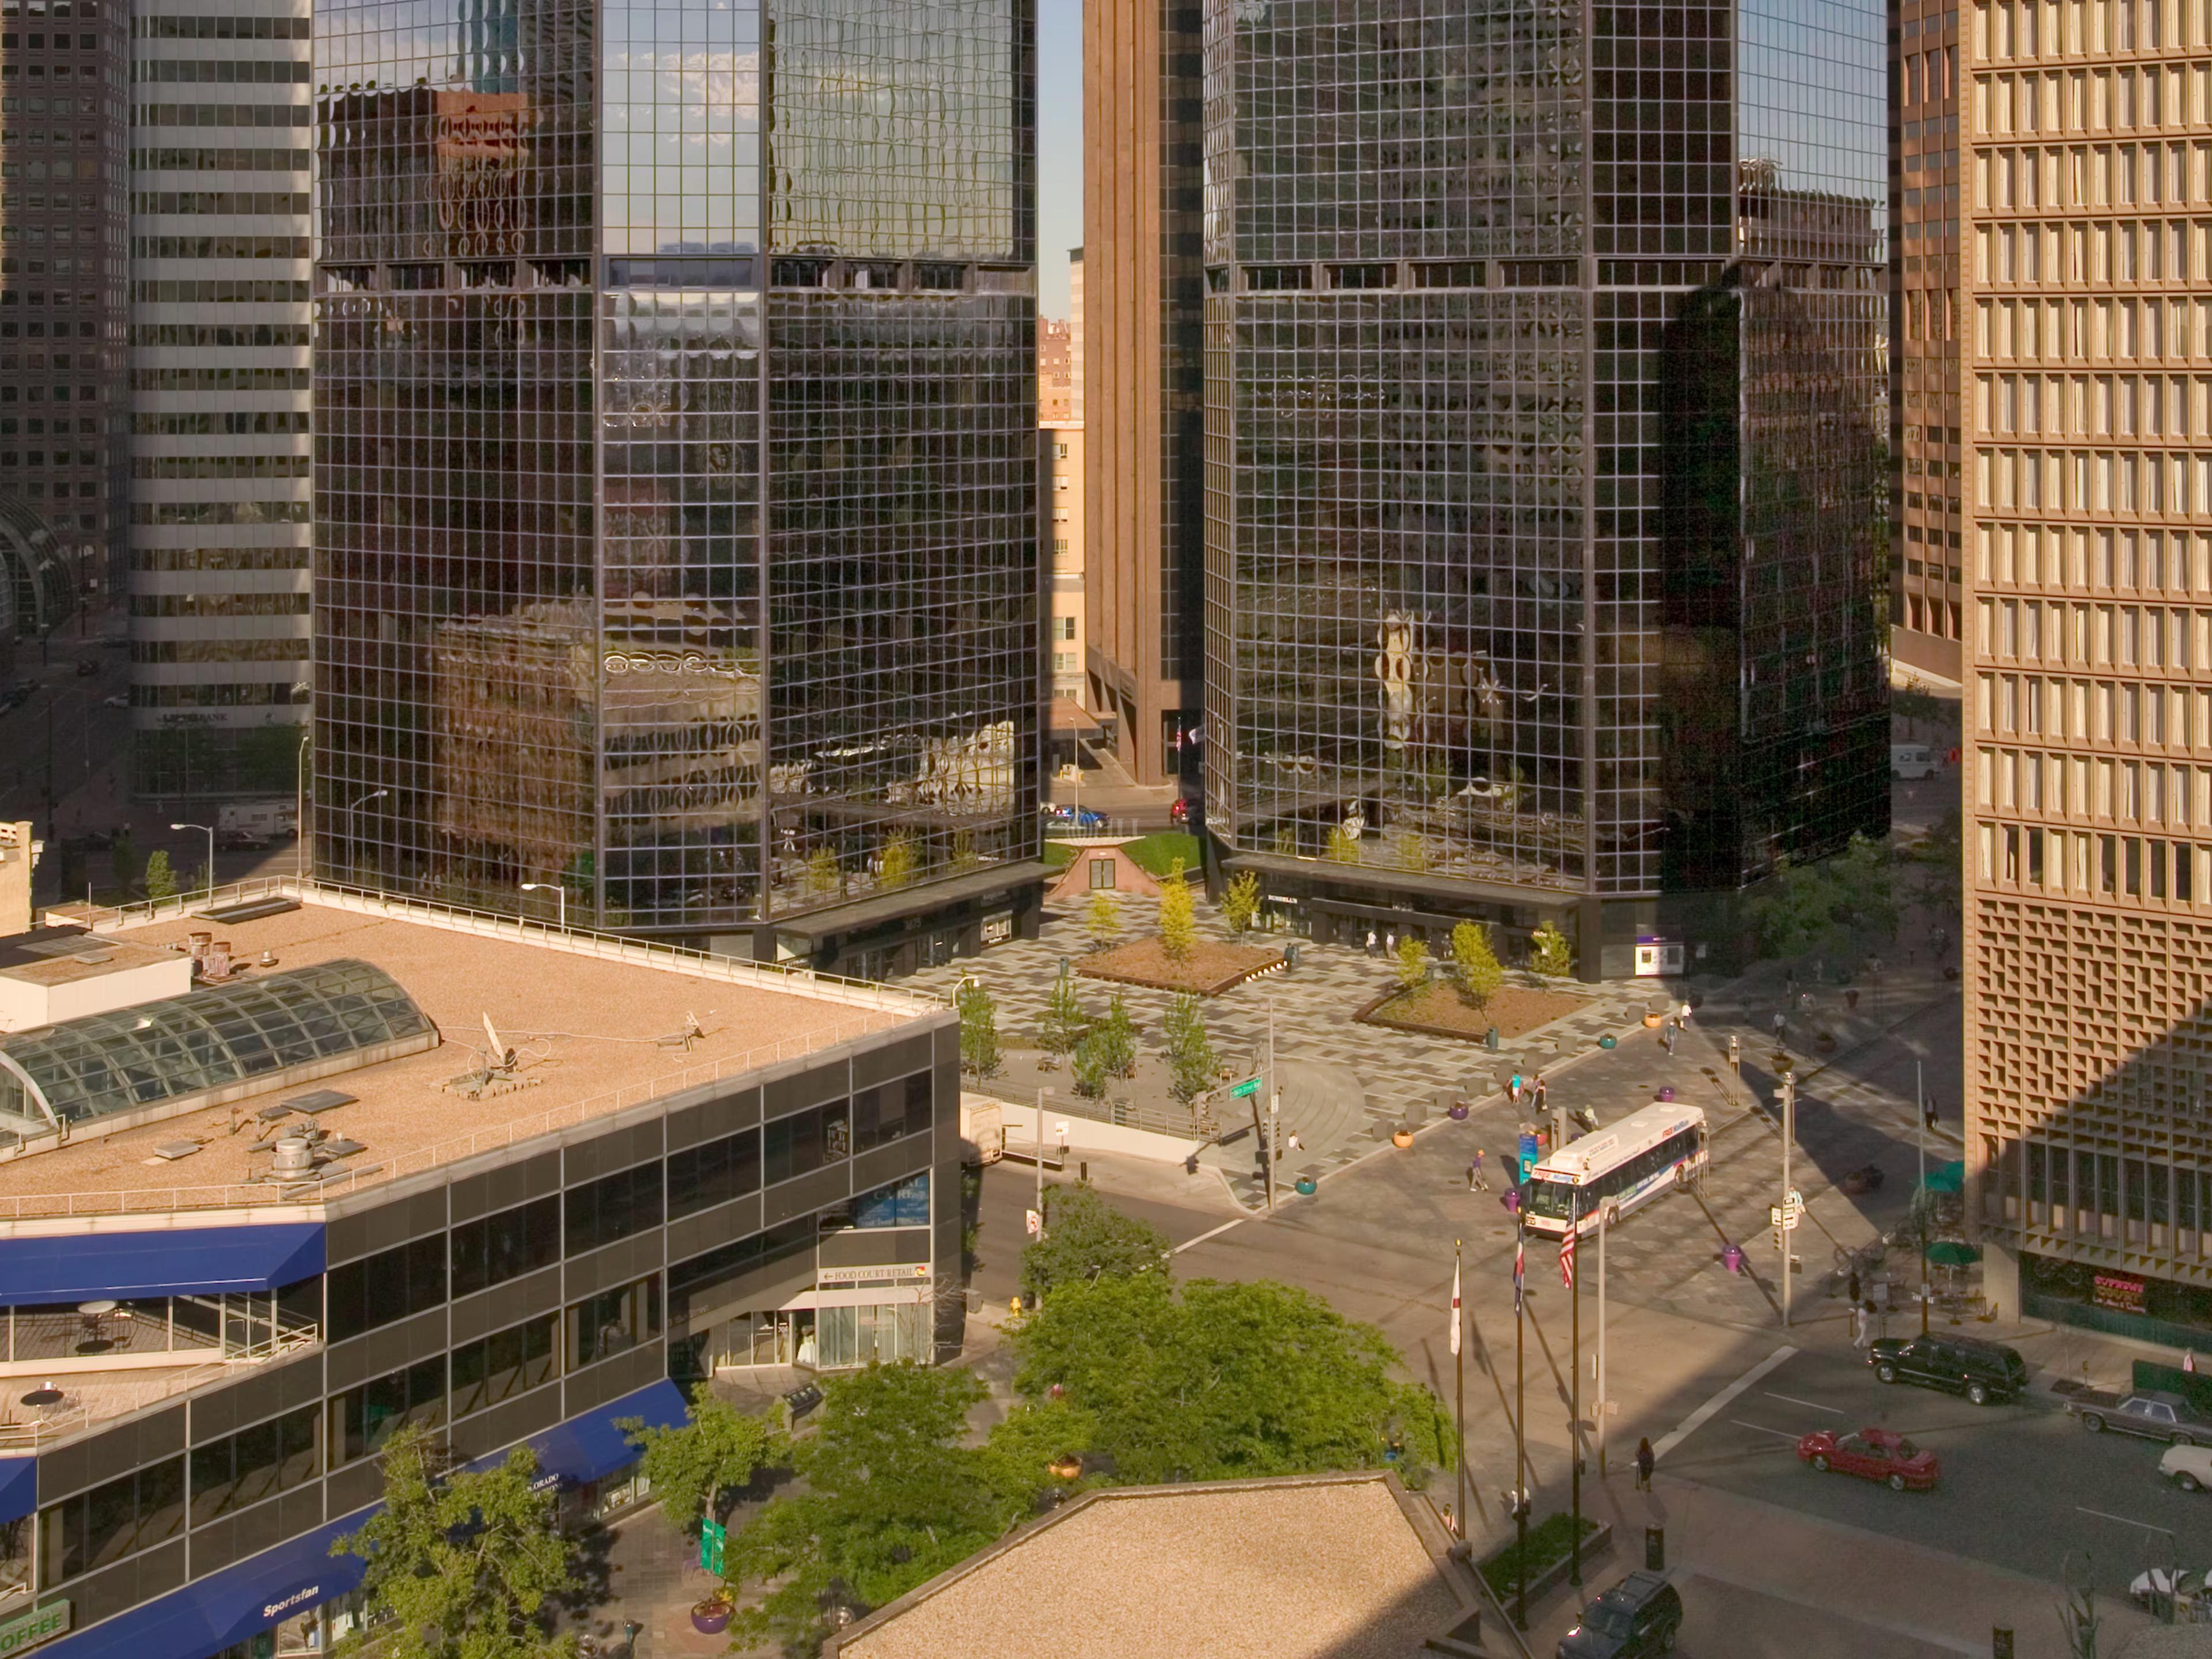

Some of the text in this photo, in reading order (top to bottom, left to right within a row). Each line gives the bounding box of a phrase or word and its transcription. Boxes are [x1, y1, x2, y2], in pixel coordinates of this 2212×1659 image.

[835, 1268, 913, 1280] FOOD COURT RETAIL
[263, 1585, 319, 1617] Sportsfan
[0, 1613, 62, 1651] OFFEE
